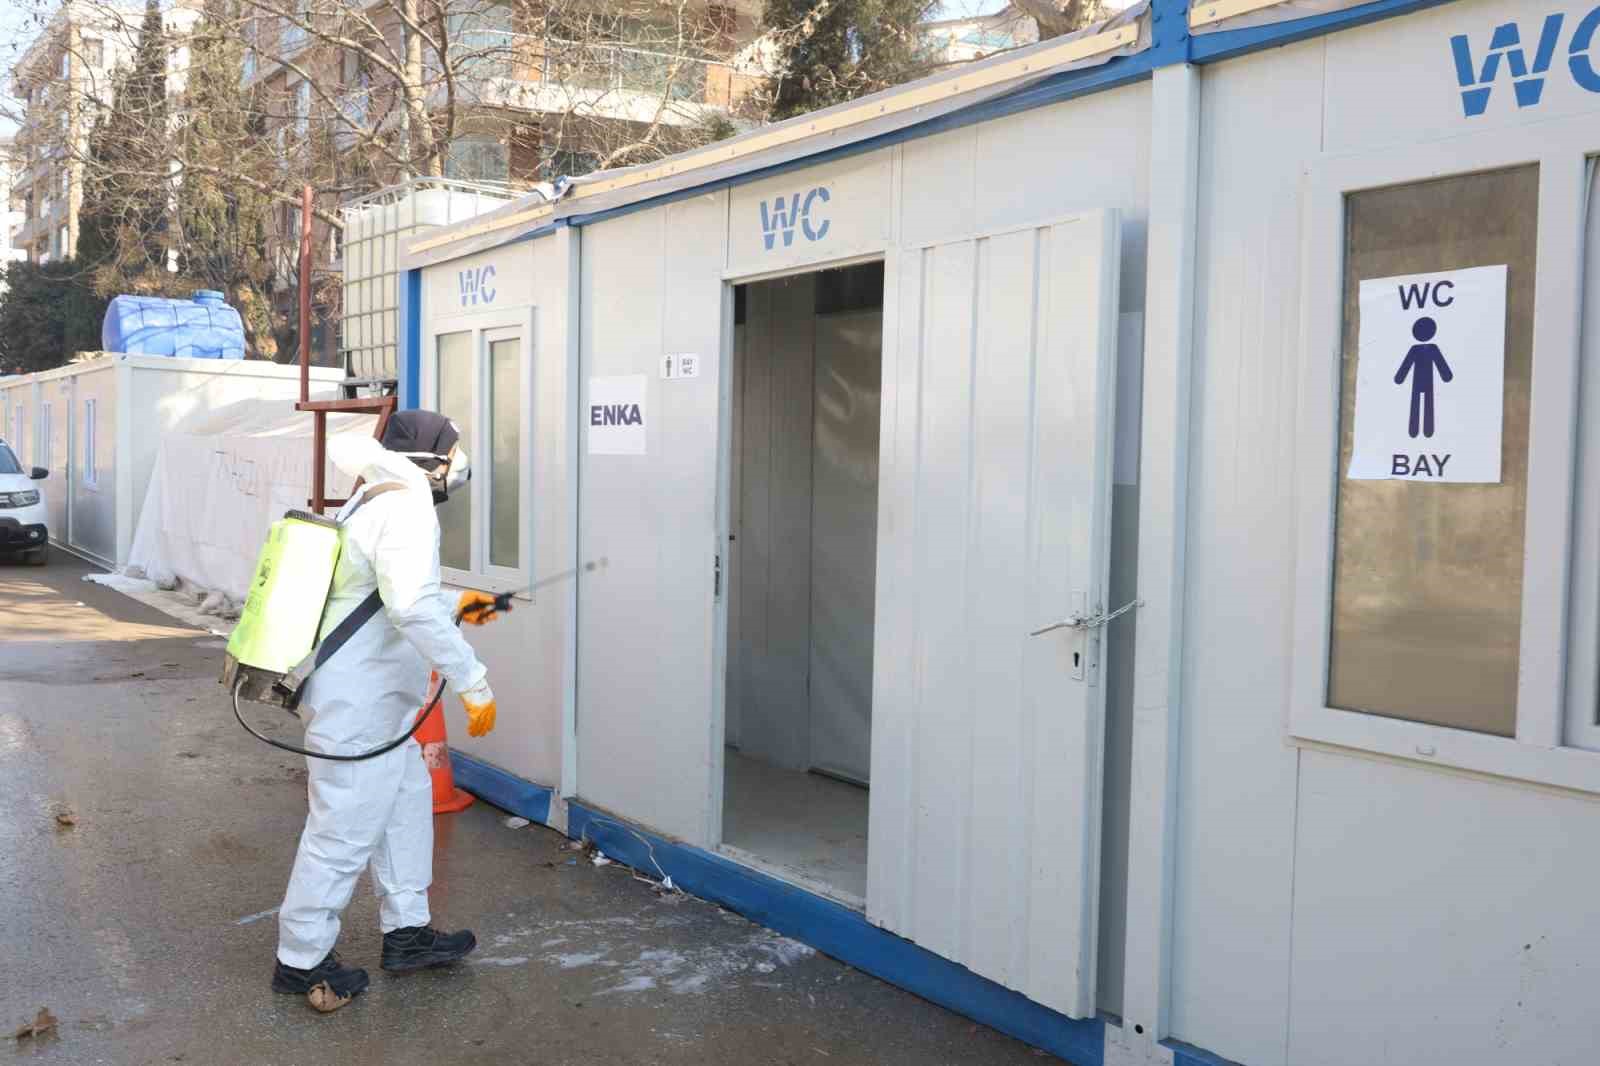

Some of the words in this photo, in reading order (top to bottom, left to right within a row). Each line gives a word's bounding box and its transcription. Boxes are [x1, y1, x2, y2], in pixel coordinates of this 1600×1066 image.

[760, 187, 830, 249] WC
[459, 266, 496, 306] WC
[1399, 281, 1454, 310] WC
[591, 404, 642, 425] ENKA
[1391, 454, 1451, 476] BAY
